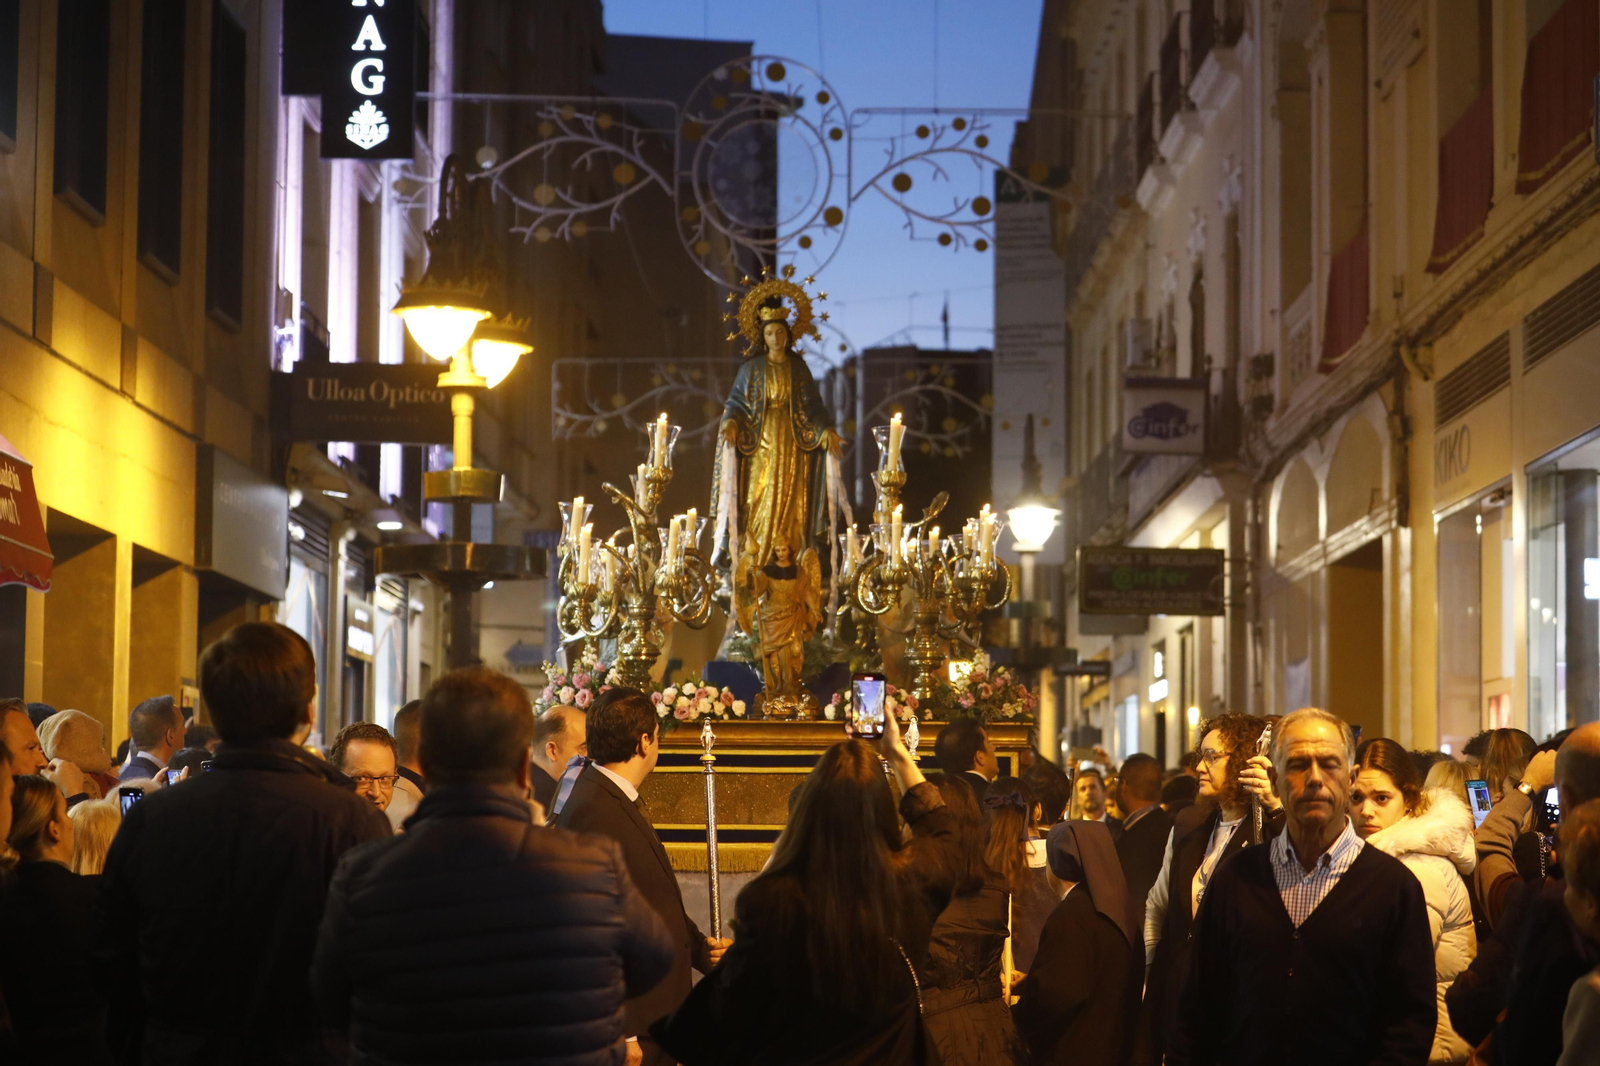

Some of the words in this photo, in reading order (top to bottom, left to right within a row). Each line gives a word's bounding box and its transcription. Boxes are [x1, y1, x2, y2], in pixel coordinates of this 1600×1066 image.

[350, 0, 387, 96] AG
[307, 377, 366, 402] Ulloa
[369, 379, 445, 410] Optico
[1434, 424, 1471, 488] KIKO
